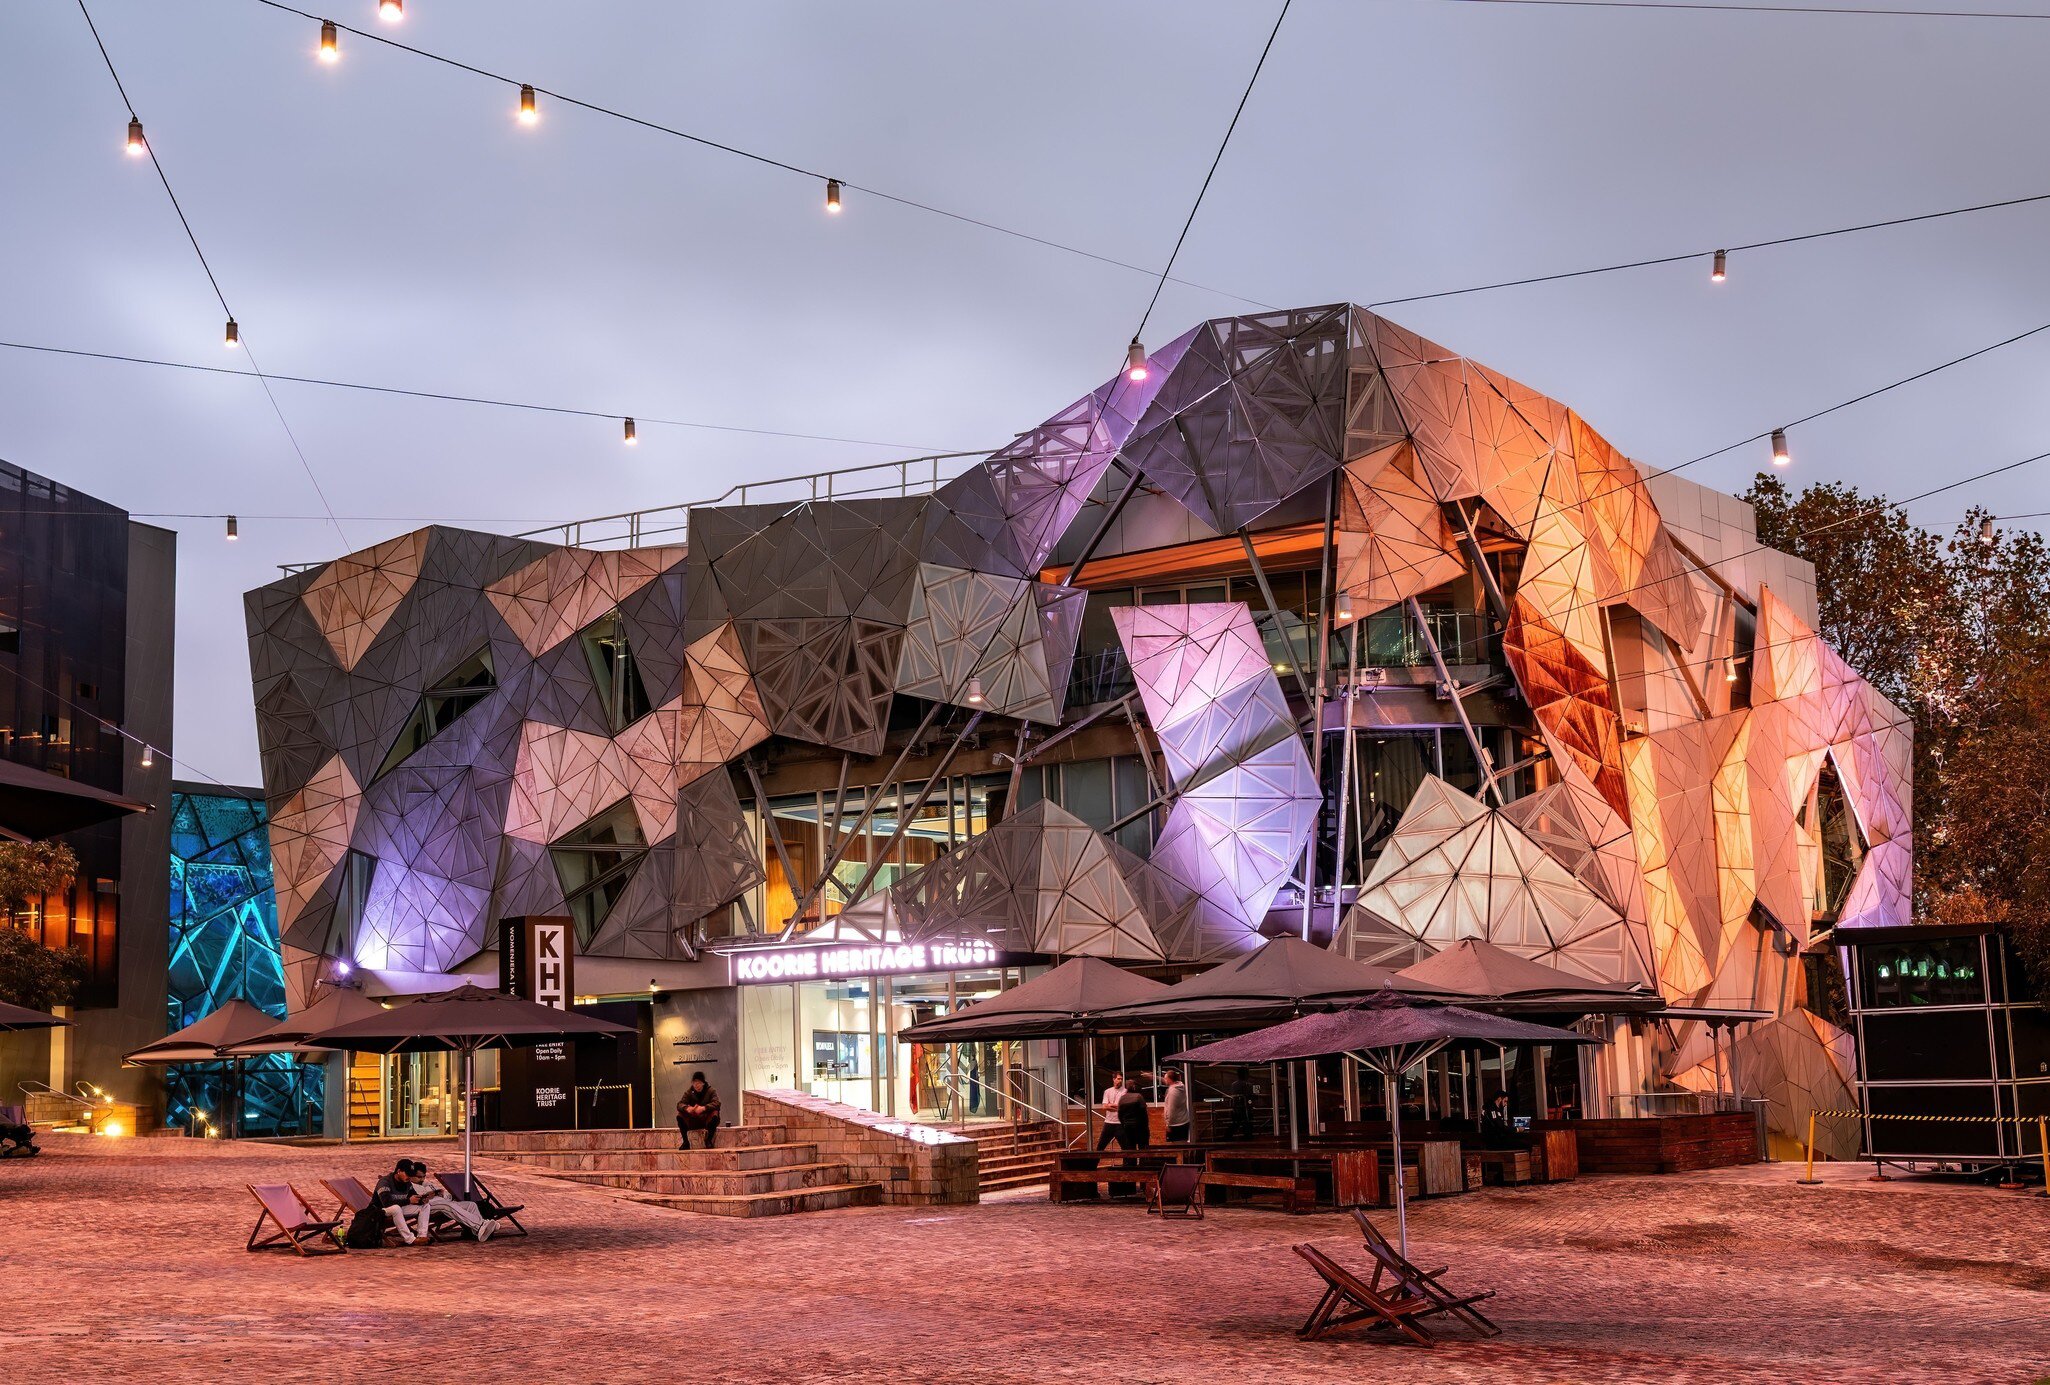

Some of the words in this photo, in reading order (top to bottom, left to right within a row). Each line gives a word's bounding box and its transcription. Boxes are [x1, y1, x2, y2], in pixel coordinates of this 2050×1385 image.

[540, 931, 560, 1008] KHT
[738, 954, 817, 979] KOORIE
[821, 946, 926, 973] HERITAGE
[931, 940, 995, 965] TRUST
